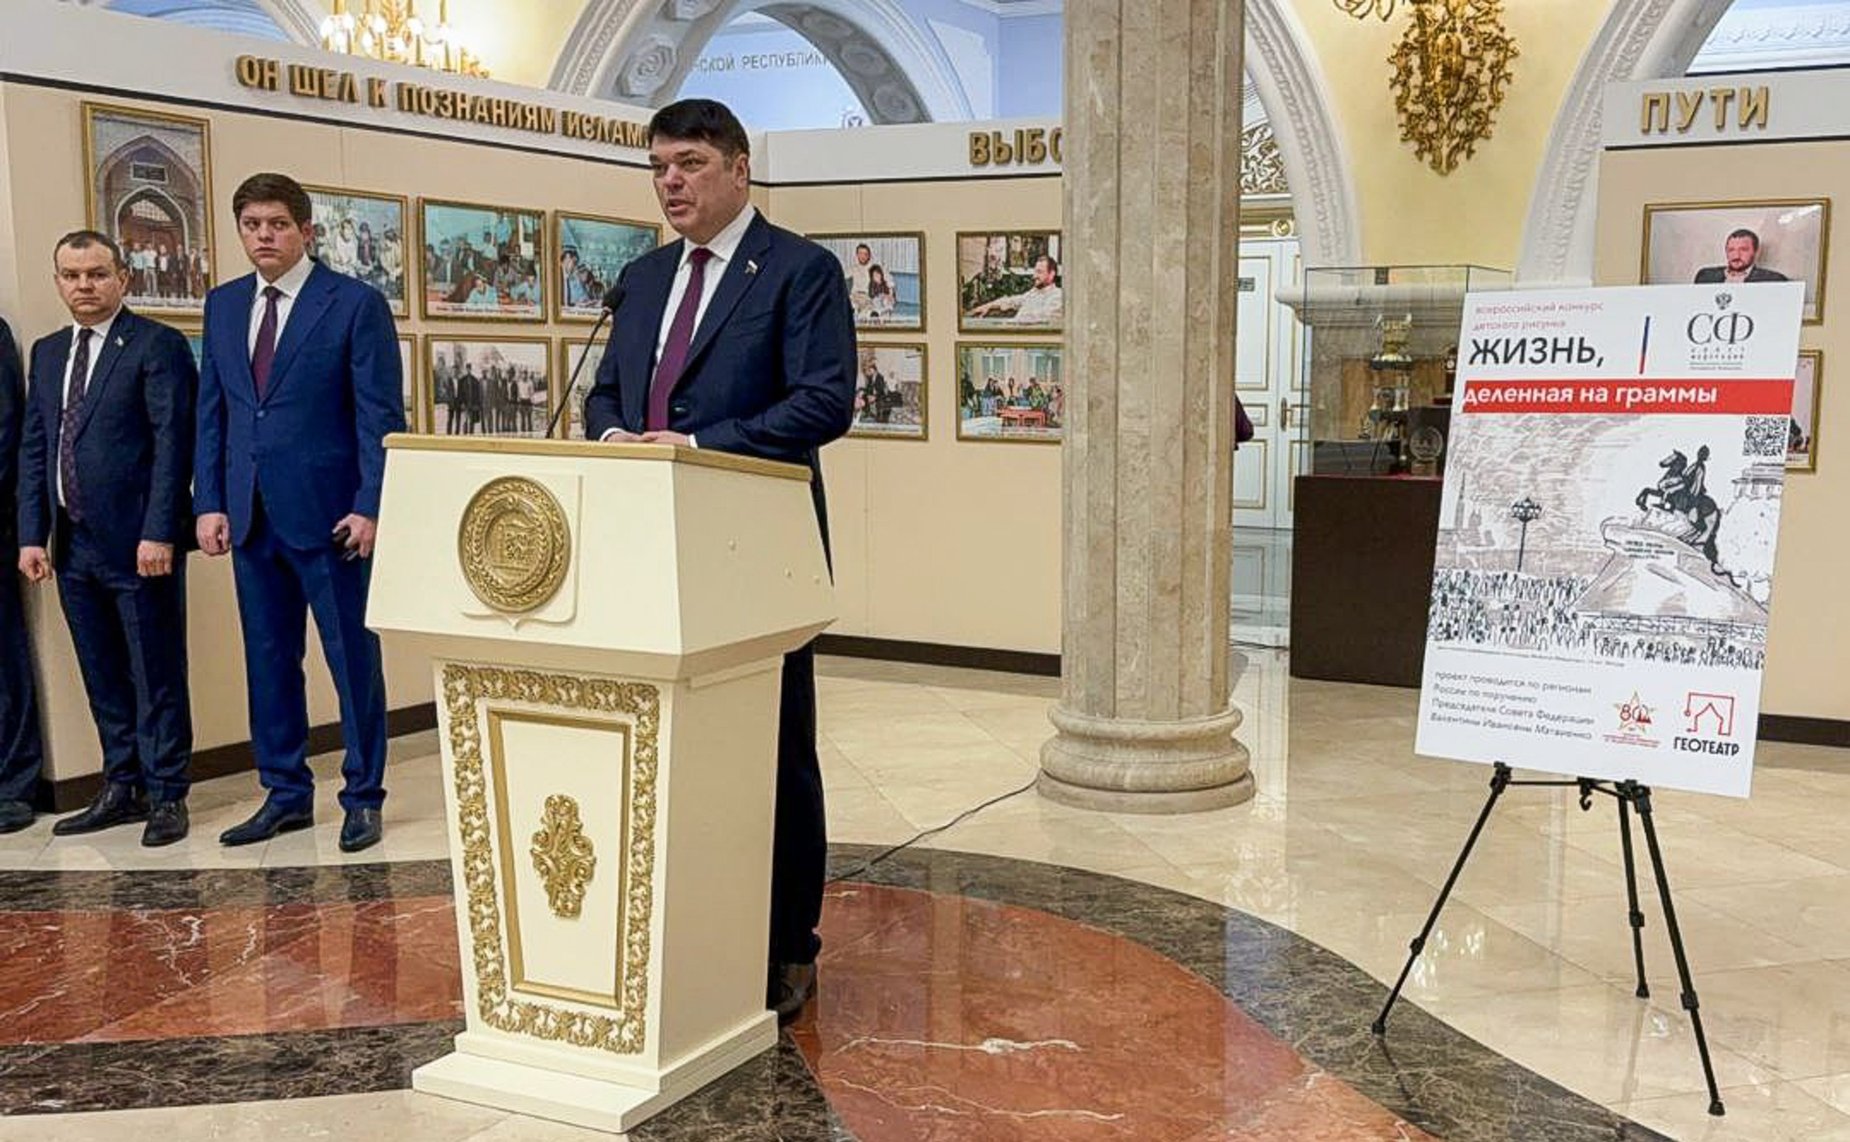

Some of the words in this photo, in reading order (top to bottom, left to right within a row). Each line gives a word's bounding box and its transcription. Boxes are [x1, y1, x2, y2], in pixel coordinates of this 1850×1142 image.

[699, 54, 735, 72] СКОЙ
[236, 54, 280, 91] ОН
[288, 64, 360, 103] ШЕЛ
[366, 78, 387, 108] К
[396, 82, 556, 134] ПОЗНАНИЯМ
[1640, 86, 1769, 134] ПУТИ
[1687, 312, 1754, 345] СФ
[1468, 336, 1604, 367] ЖИЗНЬ,
[1464, 387, 1573, 405] деленная
[1579, 387, 1608, 402] на
[1615, 386, 1717, 408] граммы
[1673, 736, 1740, 756] ГЕОТЕАТР
